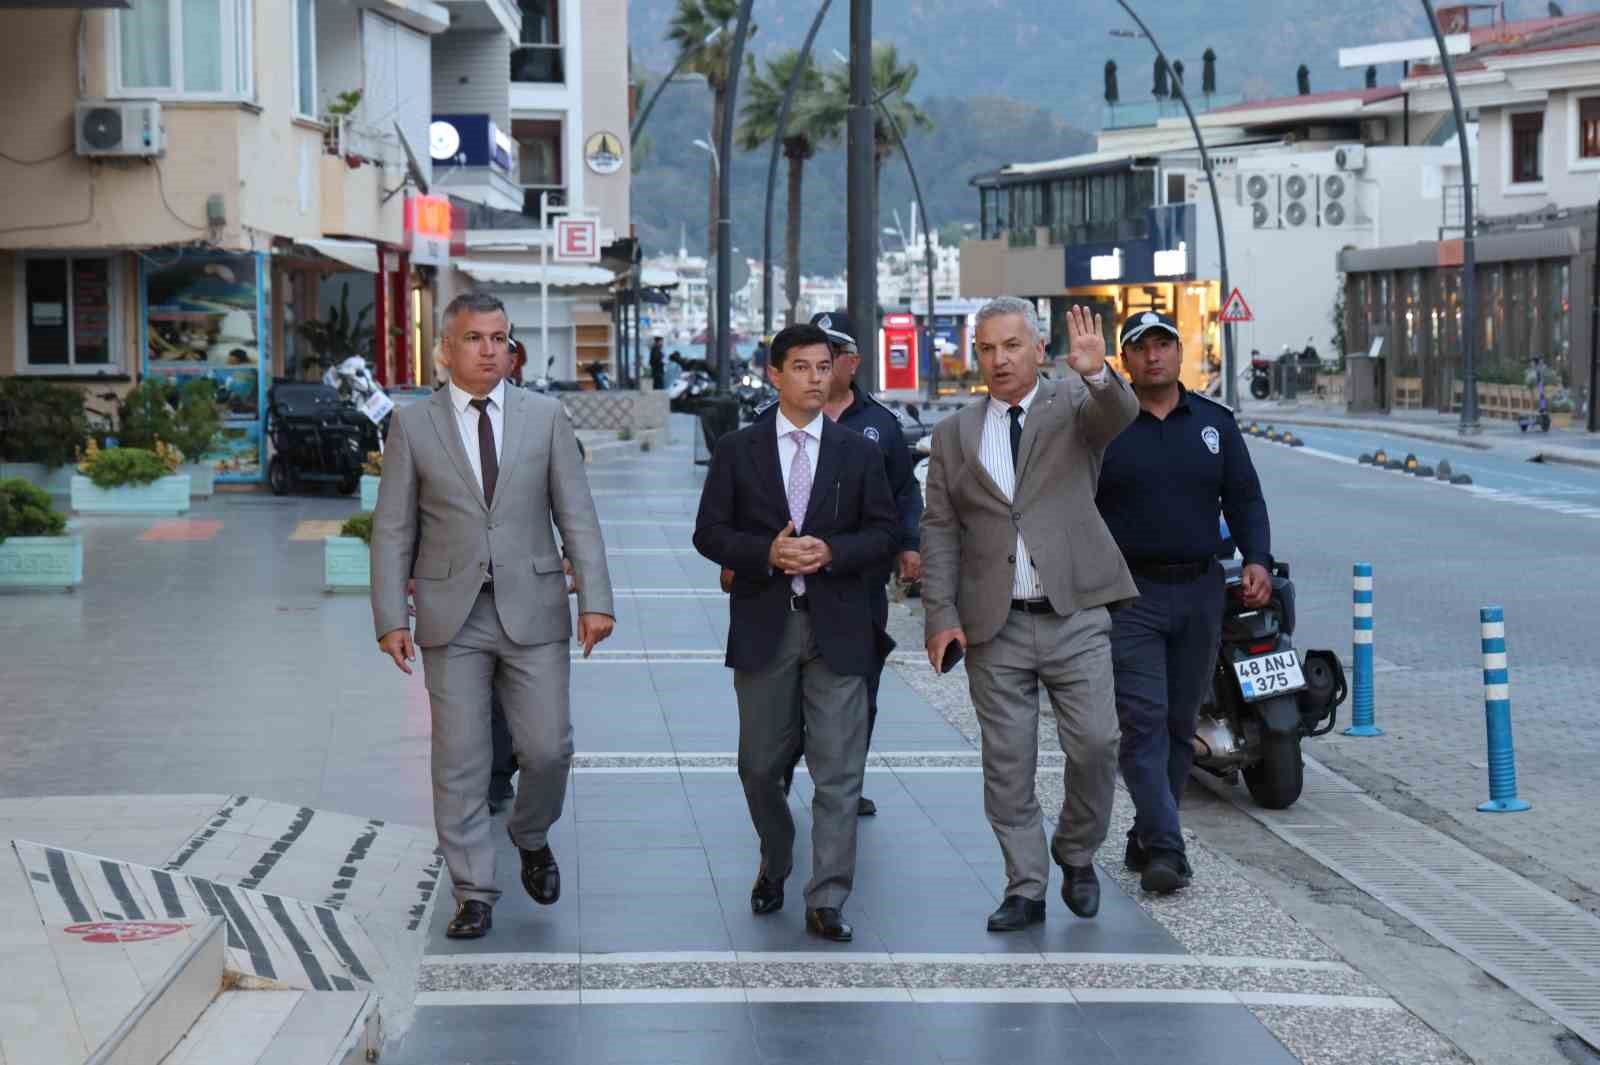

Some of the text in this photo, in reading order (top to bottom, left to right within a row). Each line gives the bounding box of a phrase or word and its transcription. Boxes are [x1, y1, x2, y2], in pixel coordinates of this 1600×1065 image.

[567, 227, 587, 252] E
[1239, 653, 1295, 677] 48 ANJ
[1256, 672, 1288, 691] 375
